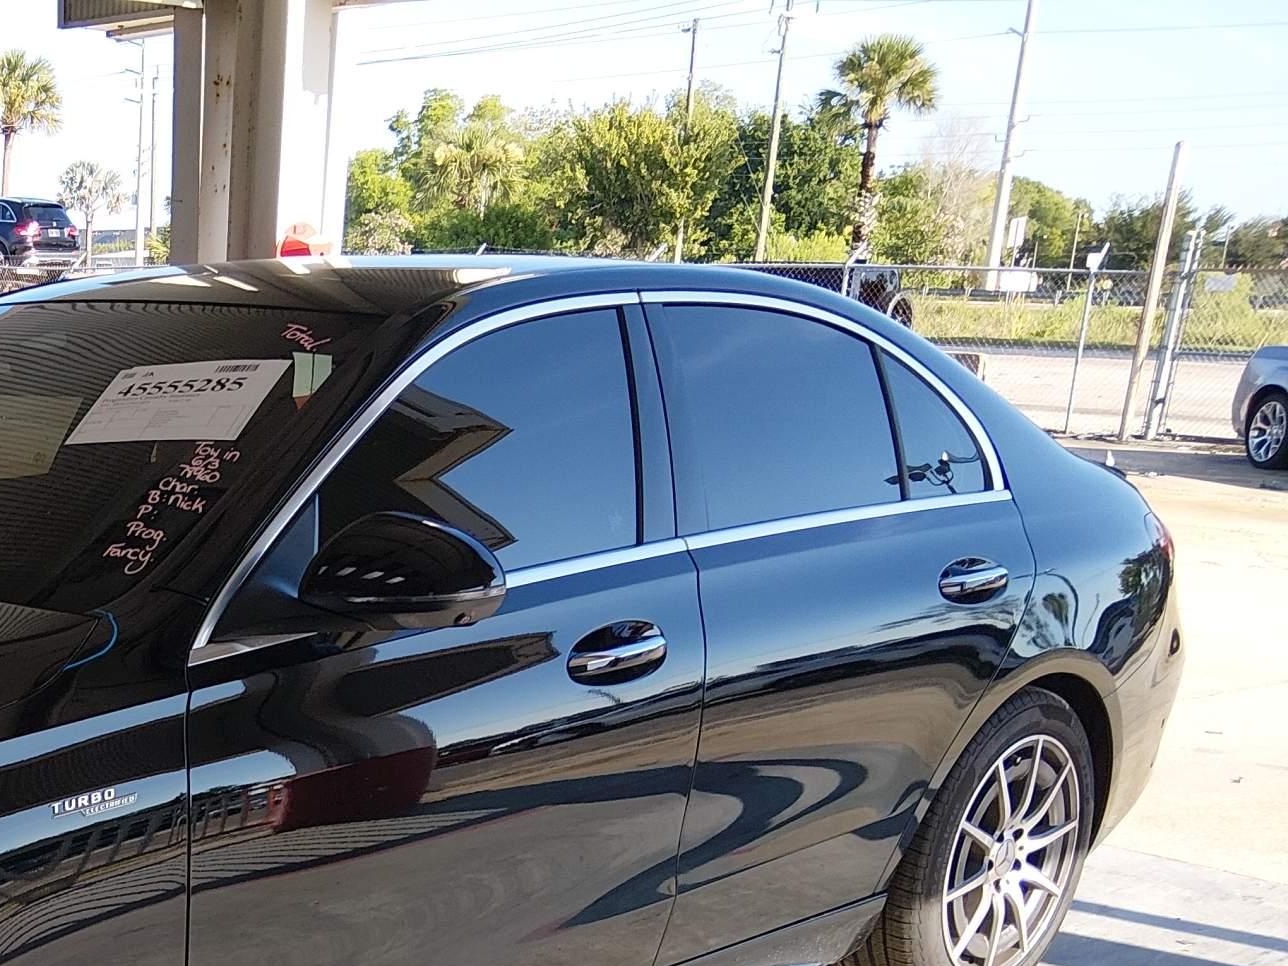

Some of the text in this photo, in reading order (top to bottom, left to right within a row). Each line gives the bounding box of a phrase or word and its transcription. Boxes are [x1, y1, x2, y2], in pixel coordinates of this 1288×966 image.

[117, 376, 248, 398] 45555285
[223, 447, 241, 462] in
[50, 788, 116, 815] TURBO
